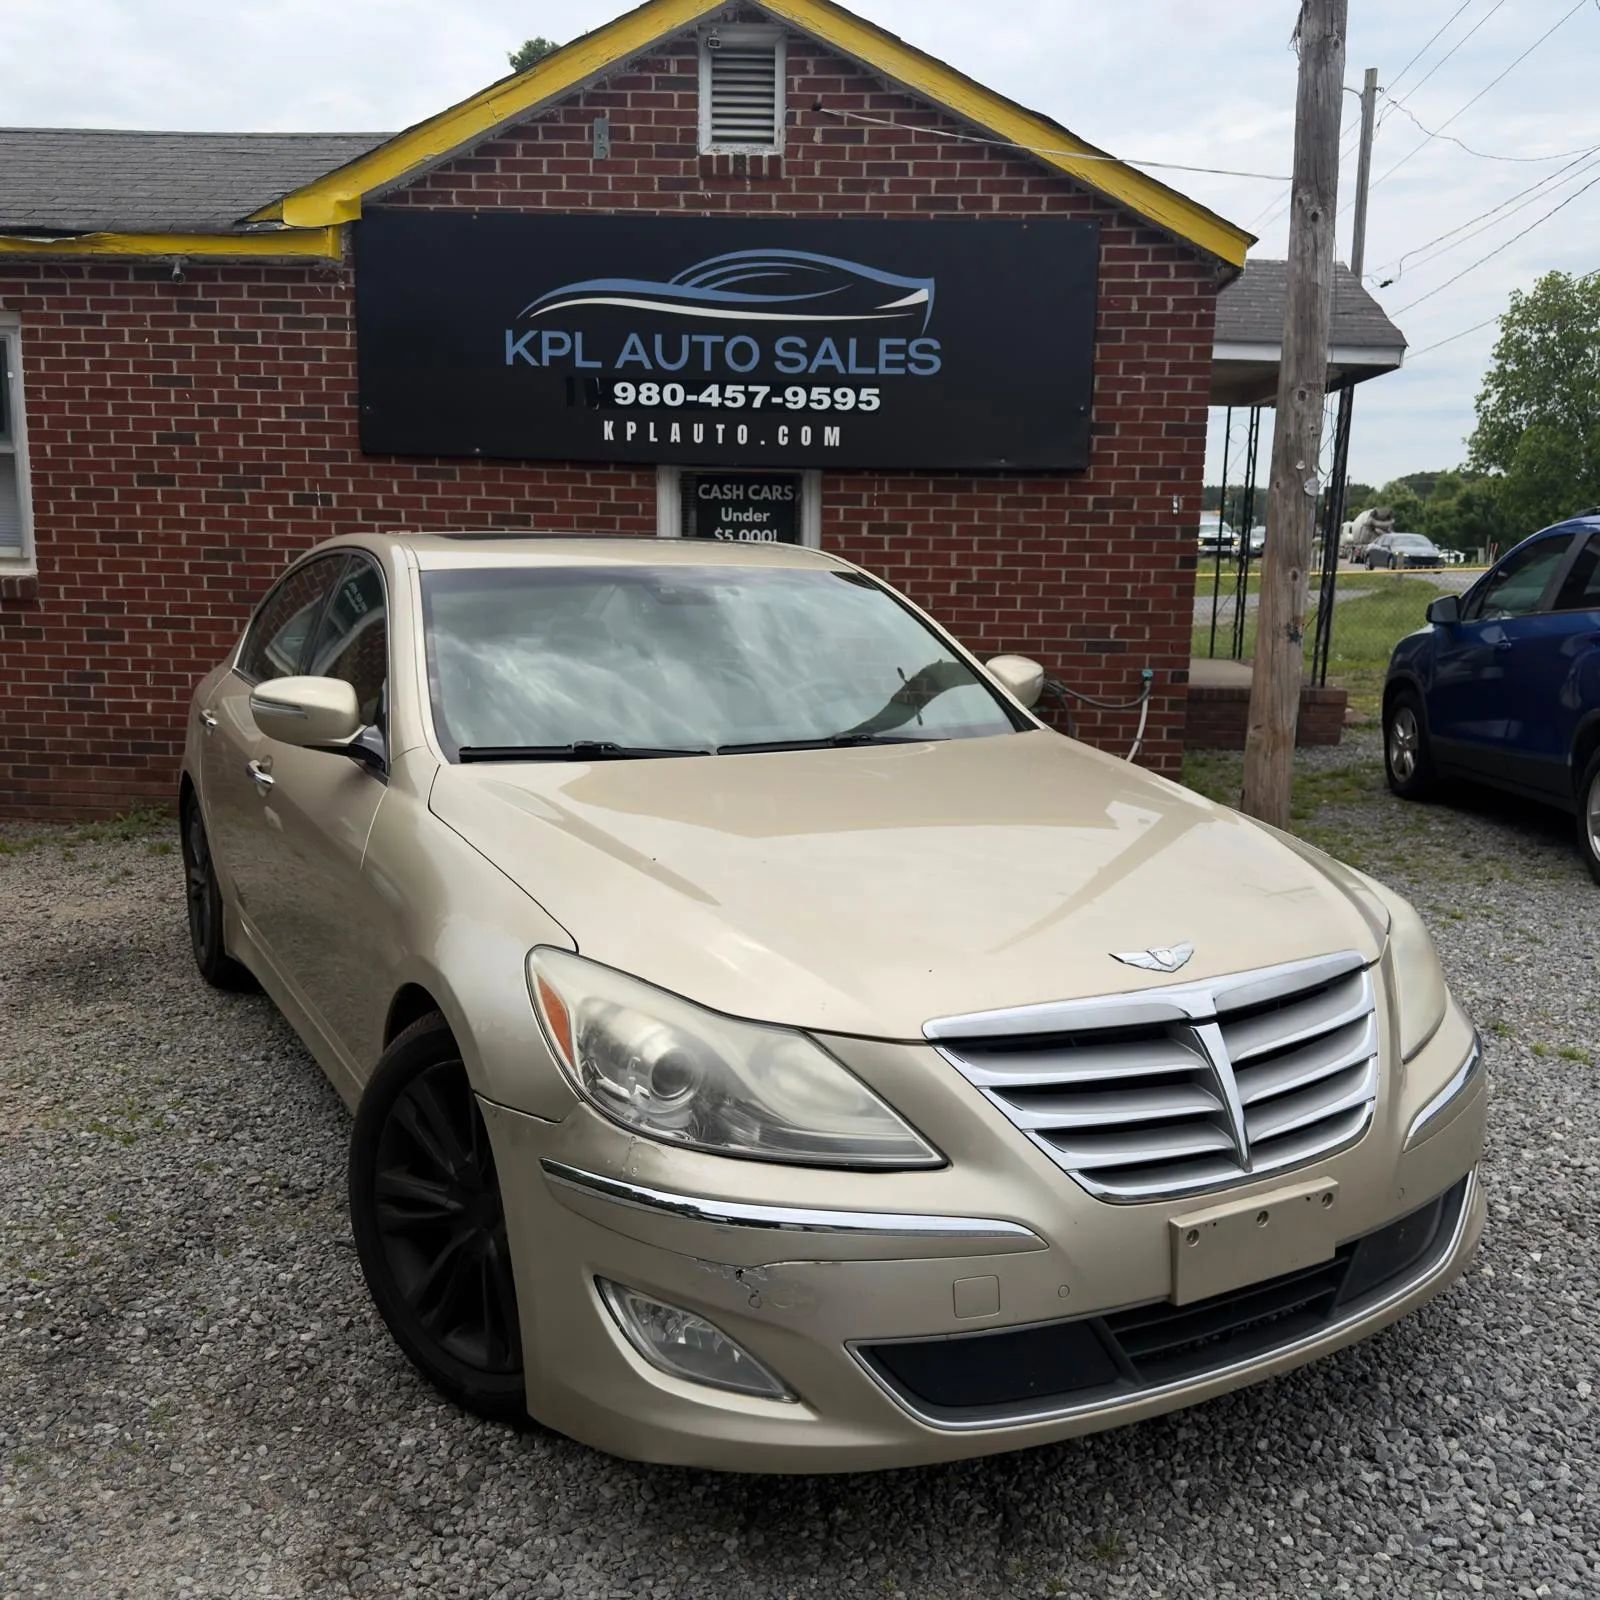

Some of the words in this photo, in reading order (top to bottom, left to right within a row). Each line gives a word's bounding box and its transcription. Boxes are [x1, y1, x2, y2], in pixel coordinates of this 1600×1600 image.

[505, 329, 602, 369] KPL
[614, 333, 760, 373] AUTO
[774, 337, 942, 376] SALES
[613, 382, 881, 411] 980-457-9595
[603, 420, 841, 447] KPLAUTO.COM
[698, 484, 744, 500] CASH
[748, 485, 794, 501] CARS
[721, 507, 771, 522] Under
[714, 527, 778, 543] $5000!
